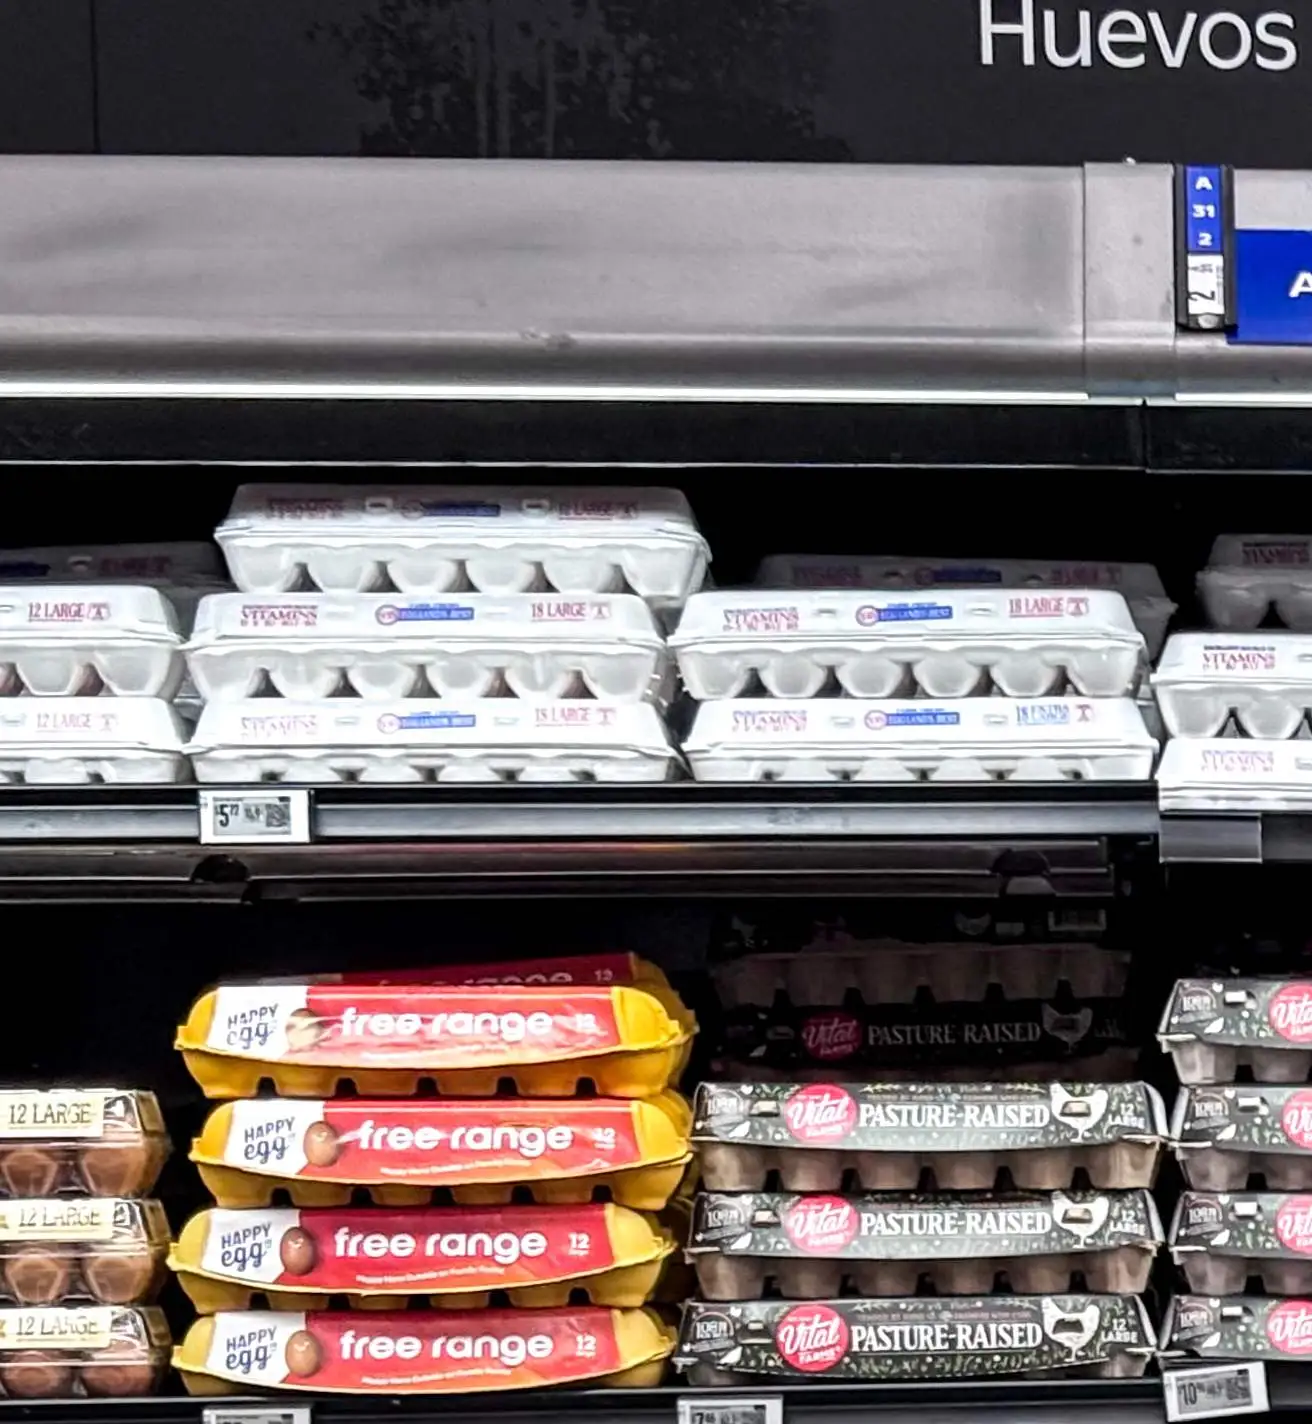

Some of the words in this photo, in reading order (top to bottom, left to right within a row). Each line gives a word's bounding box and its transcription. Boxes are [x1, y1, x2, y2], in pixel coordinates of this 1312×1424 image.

[980, 0, 1298, 70] Huevos
[1195, 176, 1212, 190] A
[1192, 204, 1215, 218] 31
[1198, 233, 1212, 246] 2
[28, 603, 43, 619] 12
[45, 602, 84, 619] LARGE
[531, 603, 542, 616] 18
[545, 602, 586, 616] LARGE
[1009, 600, 1020, 614] 18
[1024, 599, 1064, 614] LARGE
[342, 1010, 421, 1036] free
[432, 1010, 552, 1044] range
[9, 1106, 27, 1125] 12
[31, 1104, 92, 1124] LARGE
[788, 1094, 849, 1127] Vital
[859, 1104, 1049, 1128] PASTURE-RAISED
[244, 1118, 295, 1143] HAPPY
[359, 1122, 439, 1149] free
[449, 1123, 572, 1158] range
[244, 1138, 290, 1163] egg
[788, 1205, 850, 1236] Vital
[860, 1212, 1052, 1236] PASTURE-RAISED
[1109, 1221, 1145, 1234] LARGE
[1121, 1210, 1136, 1222] 12
[220, 1223, 271, 1246] HAPPY
[220, 1241, 267, 1271] egg
[335, 1230, 414, 1257] free
[425, 1231, 547, 1265] range
[569, 1234, 589, 1249] 12
[779, 1314, 841, 1350] Vital
[851, 1324, 1042, 1351] PASTURE-RAISED
[1101, 1331, 1138, 1344] LARGE
[1112, 1320, 1127, 1331] 12
[226, 1328, 277, 1352] HAPPY
[340, 1331, 421, 1359] free
[432, 1333, 553, 1369] range
[576, 1336, 596, 1352] 12
[226, 1347, 272, 1376] egg
